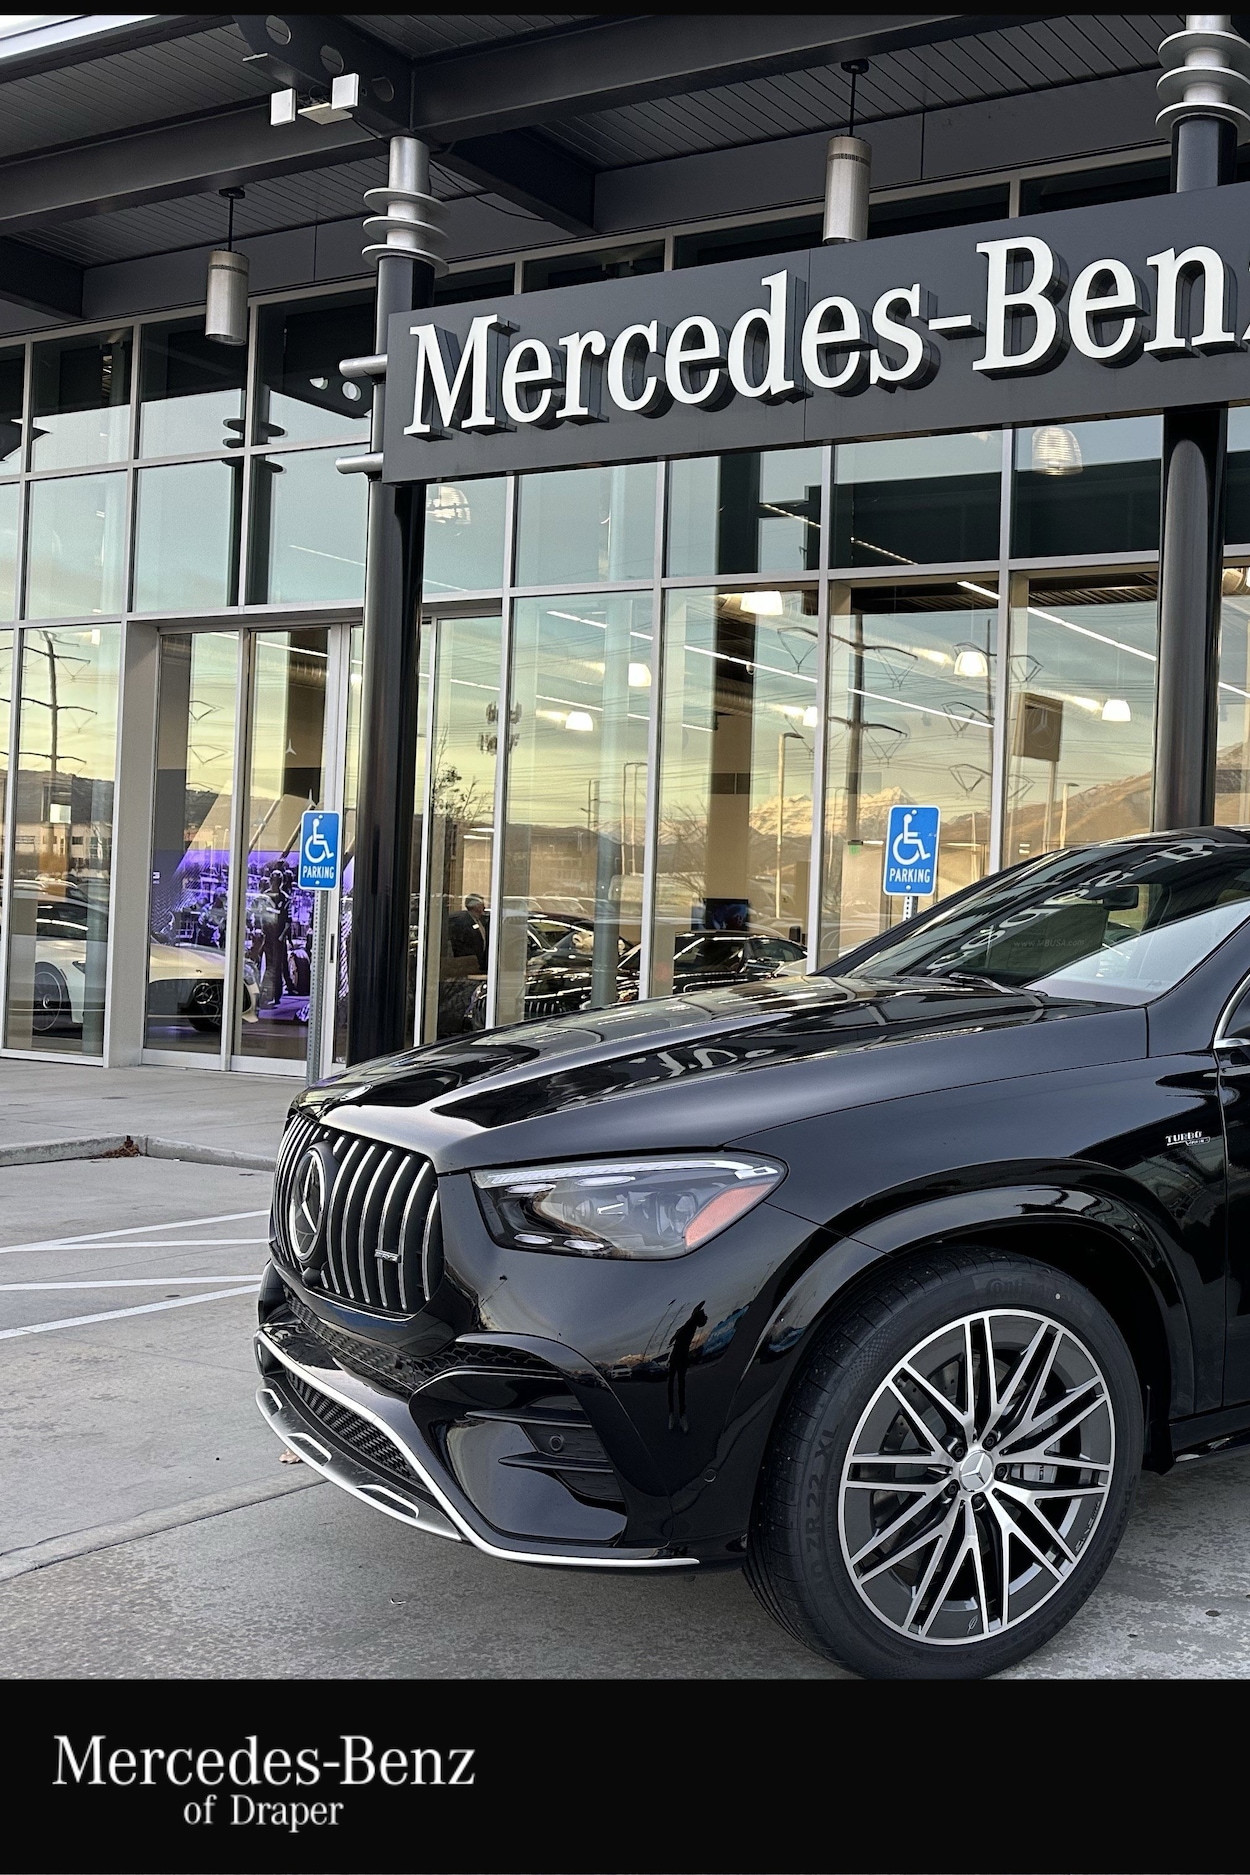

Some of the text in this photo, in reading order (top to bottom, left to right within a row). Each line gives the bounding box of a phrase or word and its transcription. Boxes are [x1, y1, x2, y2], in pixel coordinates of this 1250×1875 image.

[302, 865, 335, 879] PARKING
[889, 868, 931, 883] PARKING
[1165, 1130, 1203, 1143] TURBO
[814, 1424, 839, 1459] XL
